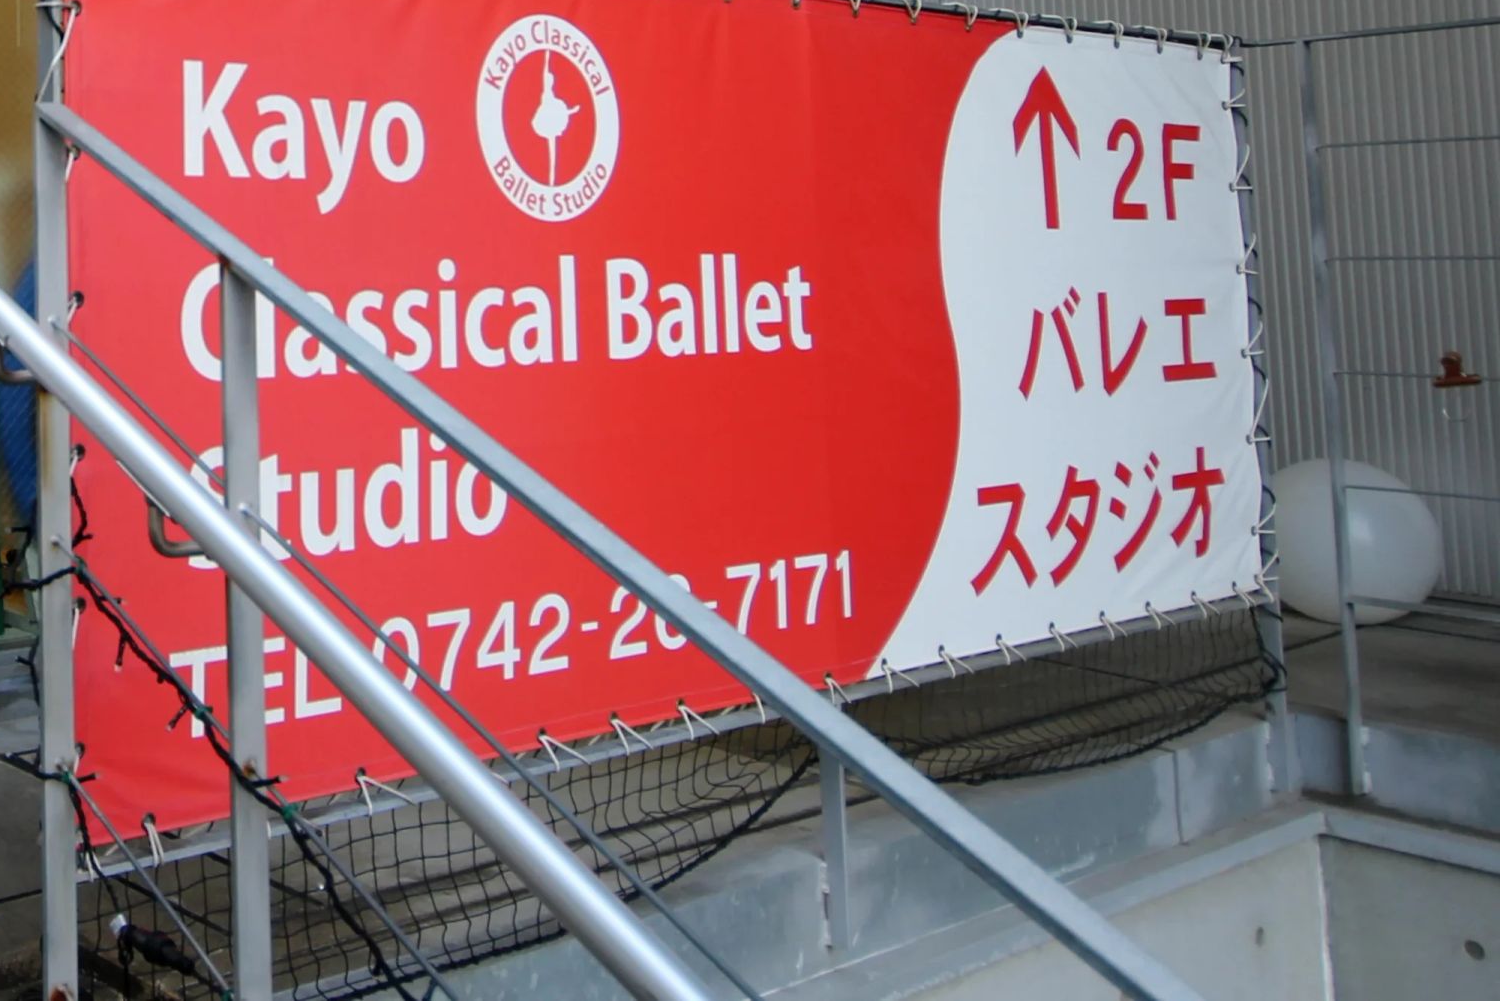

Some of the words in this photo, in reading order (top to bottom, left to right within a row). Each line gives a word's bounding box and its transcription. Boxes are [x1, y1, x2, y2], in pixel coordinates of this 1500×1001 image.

[484, 33, 527, 91] Kayo
[530, 19, 610, 96] Classical
[182, 59, 426, 215] Kayo
[493, 155, 547, 216] Ballet
[552, 162, 608, 217] Studio
[1106, 118, 1201, 221] 2F
[180, 253, 579, 383] Classical
[605, 253, 813, 361] Ballet
[1018, 286, 1218, 401] バレエ
[969, 446, 1226, 596] スタジオ
